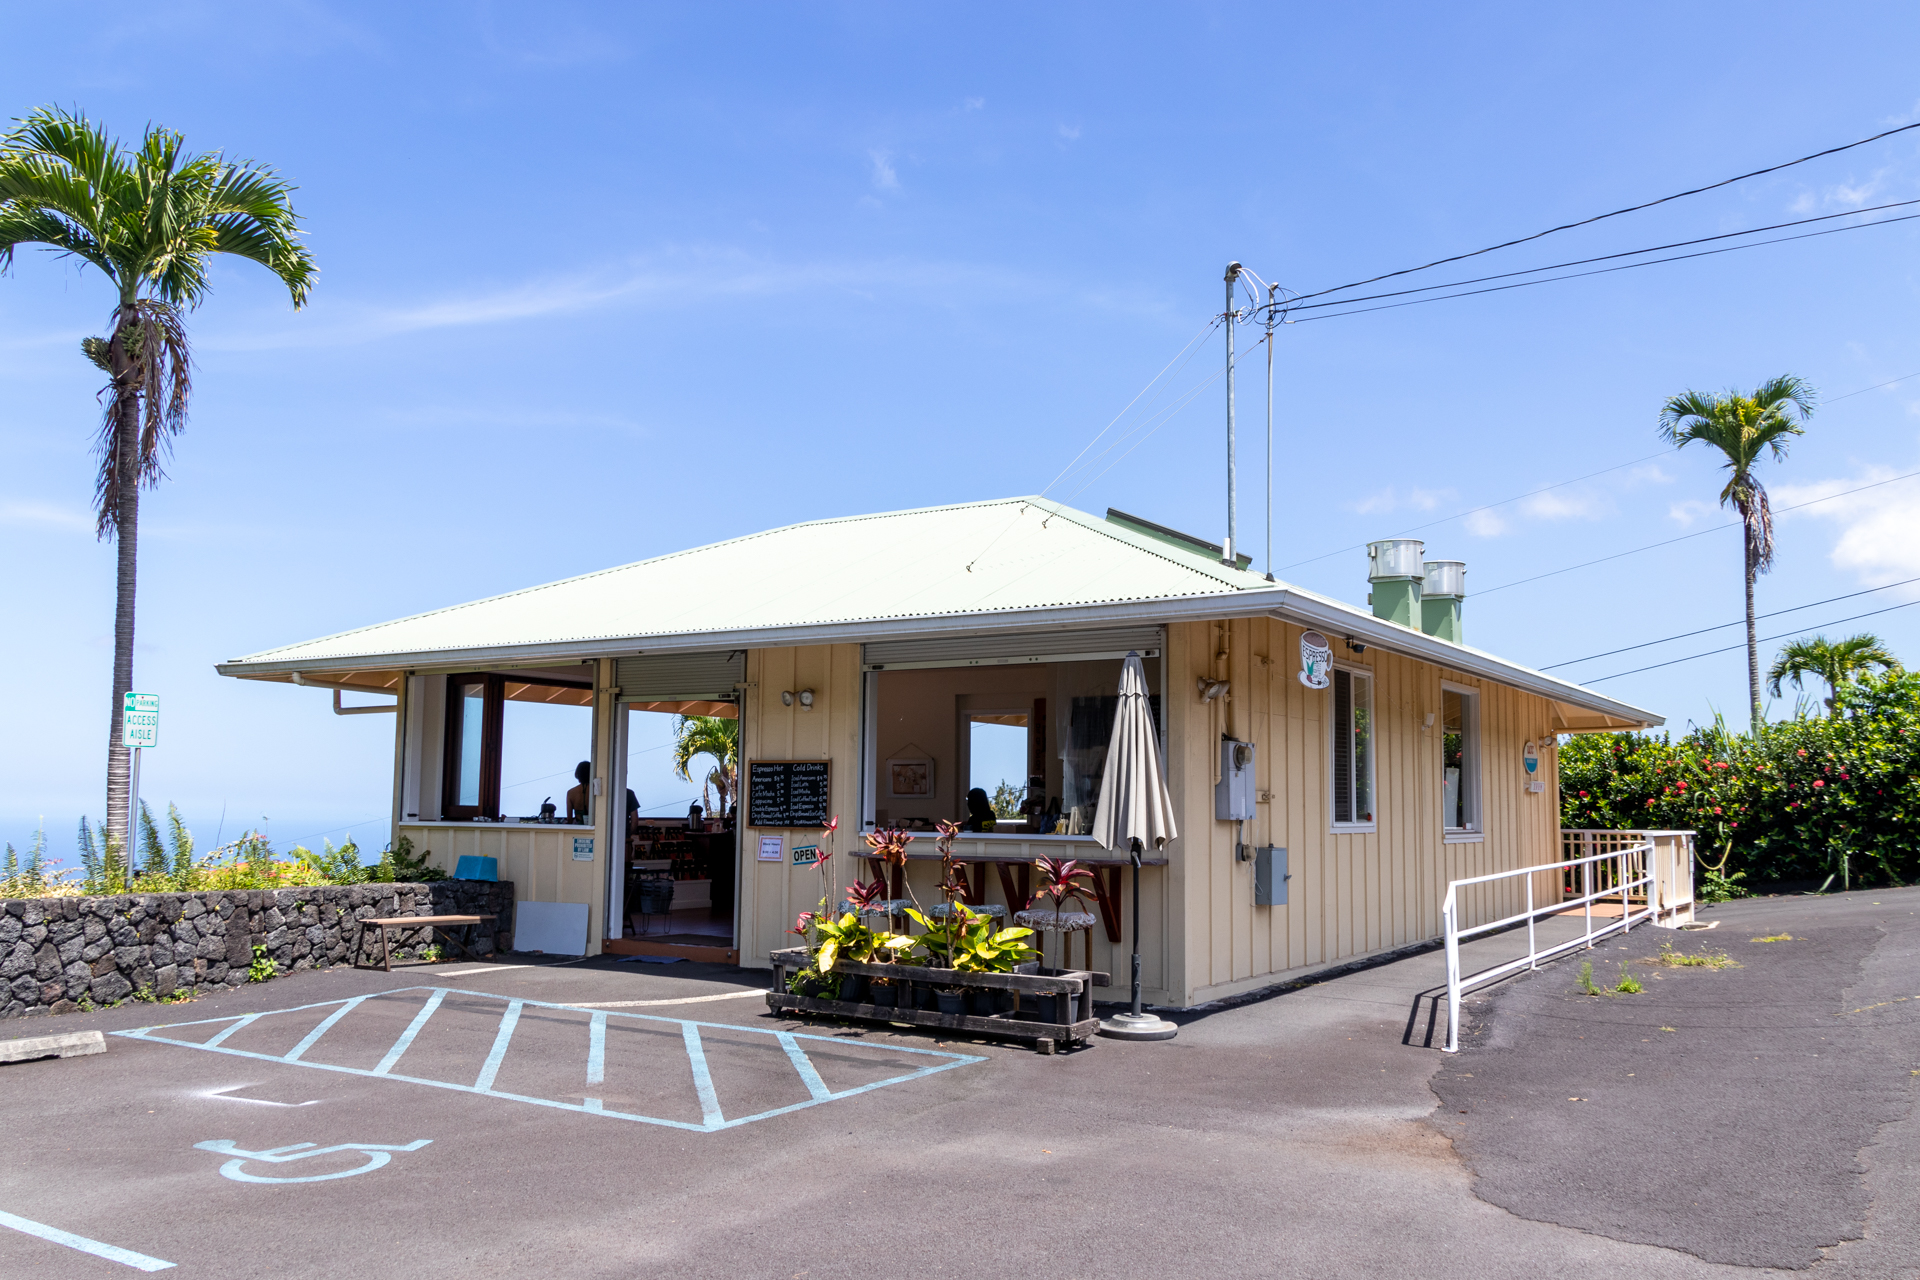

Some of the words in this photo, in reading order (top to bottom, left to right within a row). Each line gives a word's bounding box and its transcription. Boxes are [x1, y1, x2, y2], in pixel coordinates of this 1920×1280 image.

[1302, 645, 1328, 663] ESPRESSO
[125, 697, 135, 707] NO
[127, 715, 156, 726] ACCESS
[130, 729, 152, 739] AISLE
[752, 764, 773, 774] Espresso
[773, 764, 784, 772] Hot
[792, 763, 806, 772] Cold
[806, 763, 824, 771] Drinks
[794, 848, 816, 862] OPEN
